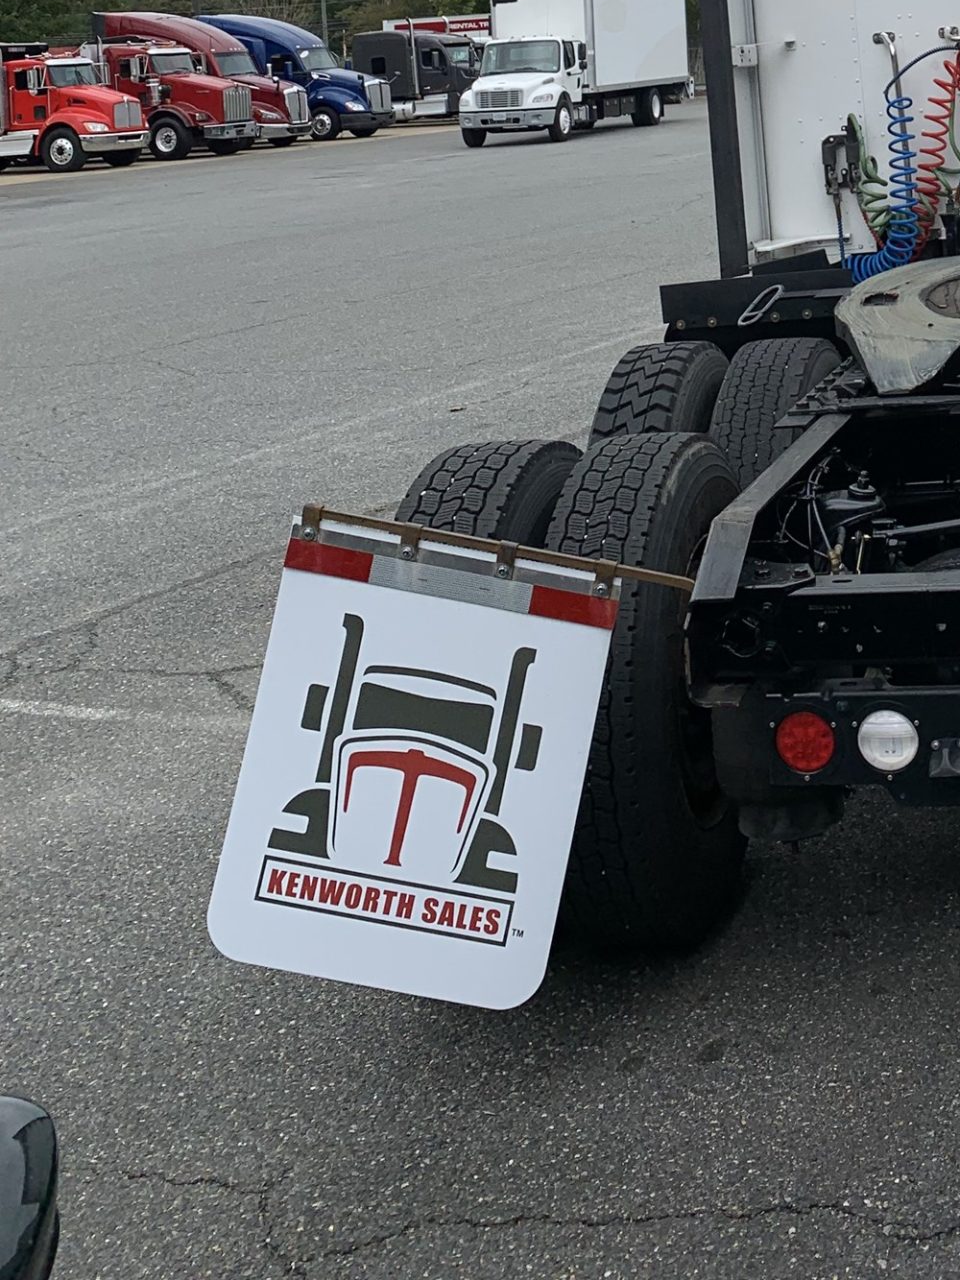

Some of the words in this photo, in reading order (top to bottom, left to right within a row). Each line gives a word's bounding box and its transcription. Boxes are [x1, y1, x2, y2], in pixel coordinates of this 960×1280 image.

[267, 869, 415, 919] KENWORTH
[422, 898, 501, 934] SALES
[510, 927, 525, 938] TM
